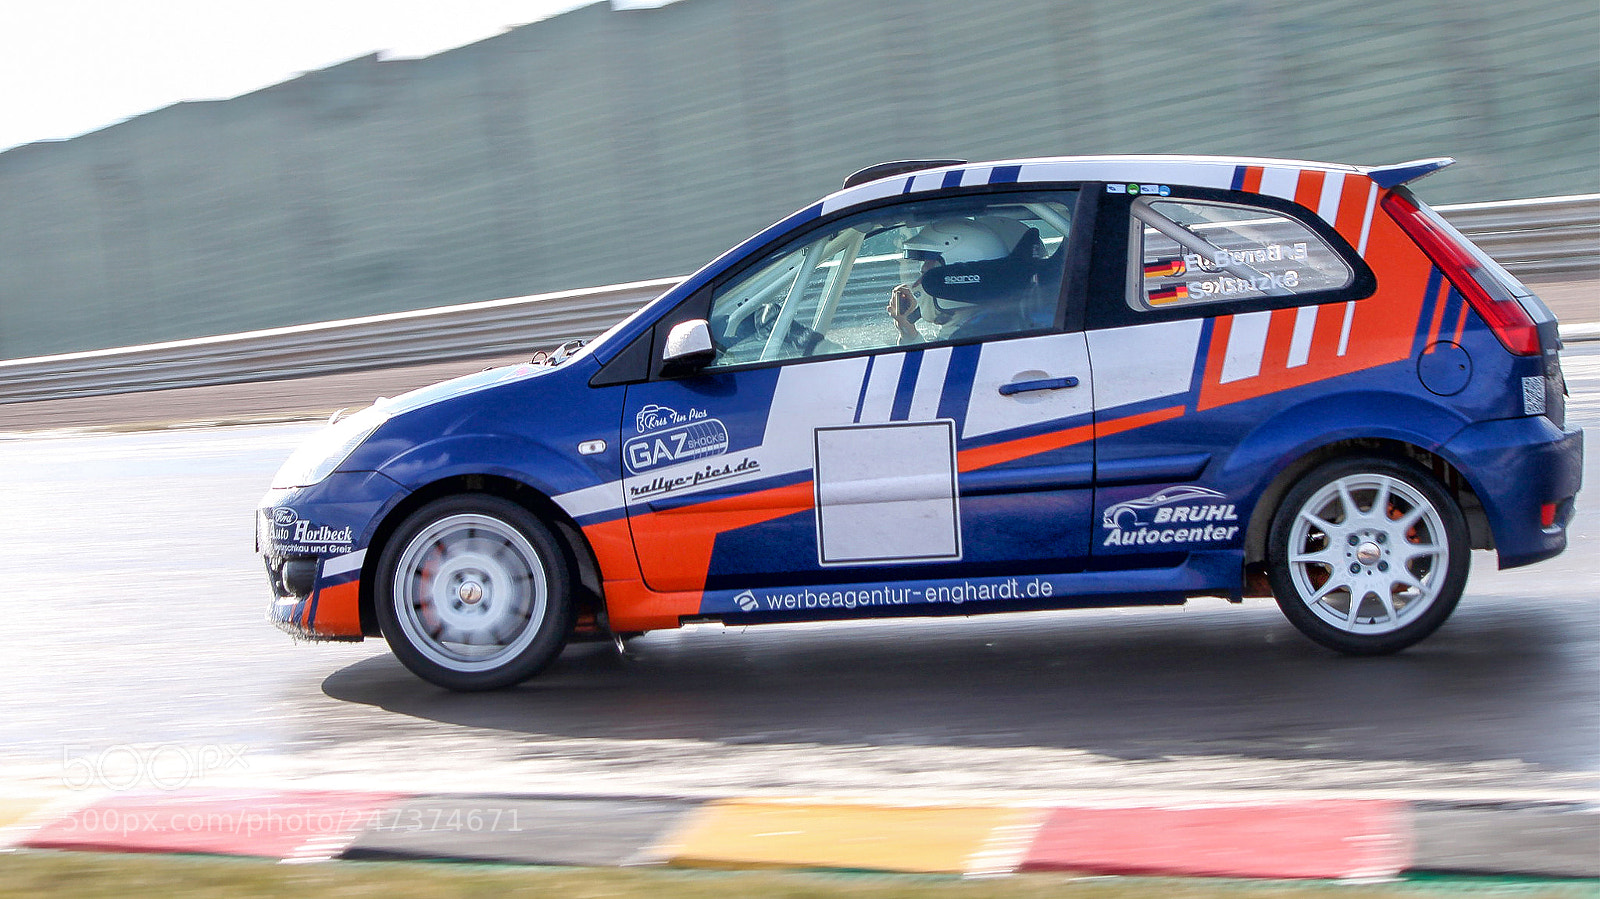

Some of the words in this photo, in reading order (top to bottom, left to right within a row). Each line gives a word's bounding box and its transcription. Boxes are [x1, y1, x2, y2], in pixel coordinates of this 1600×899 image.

[944, 274, 980, 282] sparco
[648, 414, 668, 428] Kris
[689, 408, 708, 421] Pics
[629, 432, 687, 469] GAZ
[687, 432, 725, 449] SHOCKS
[631, 457, 760, 496] rallye-pics.de
[293, 520, 352, 541] Horlbeck
[1103, 524, 1239, 547] Autocenter
[311, 544, 327, 553] und
[329, 544, 352, 553] Greiz
[767, 578, 1053, 610] werbeagentur-enghardt.de
